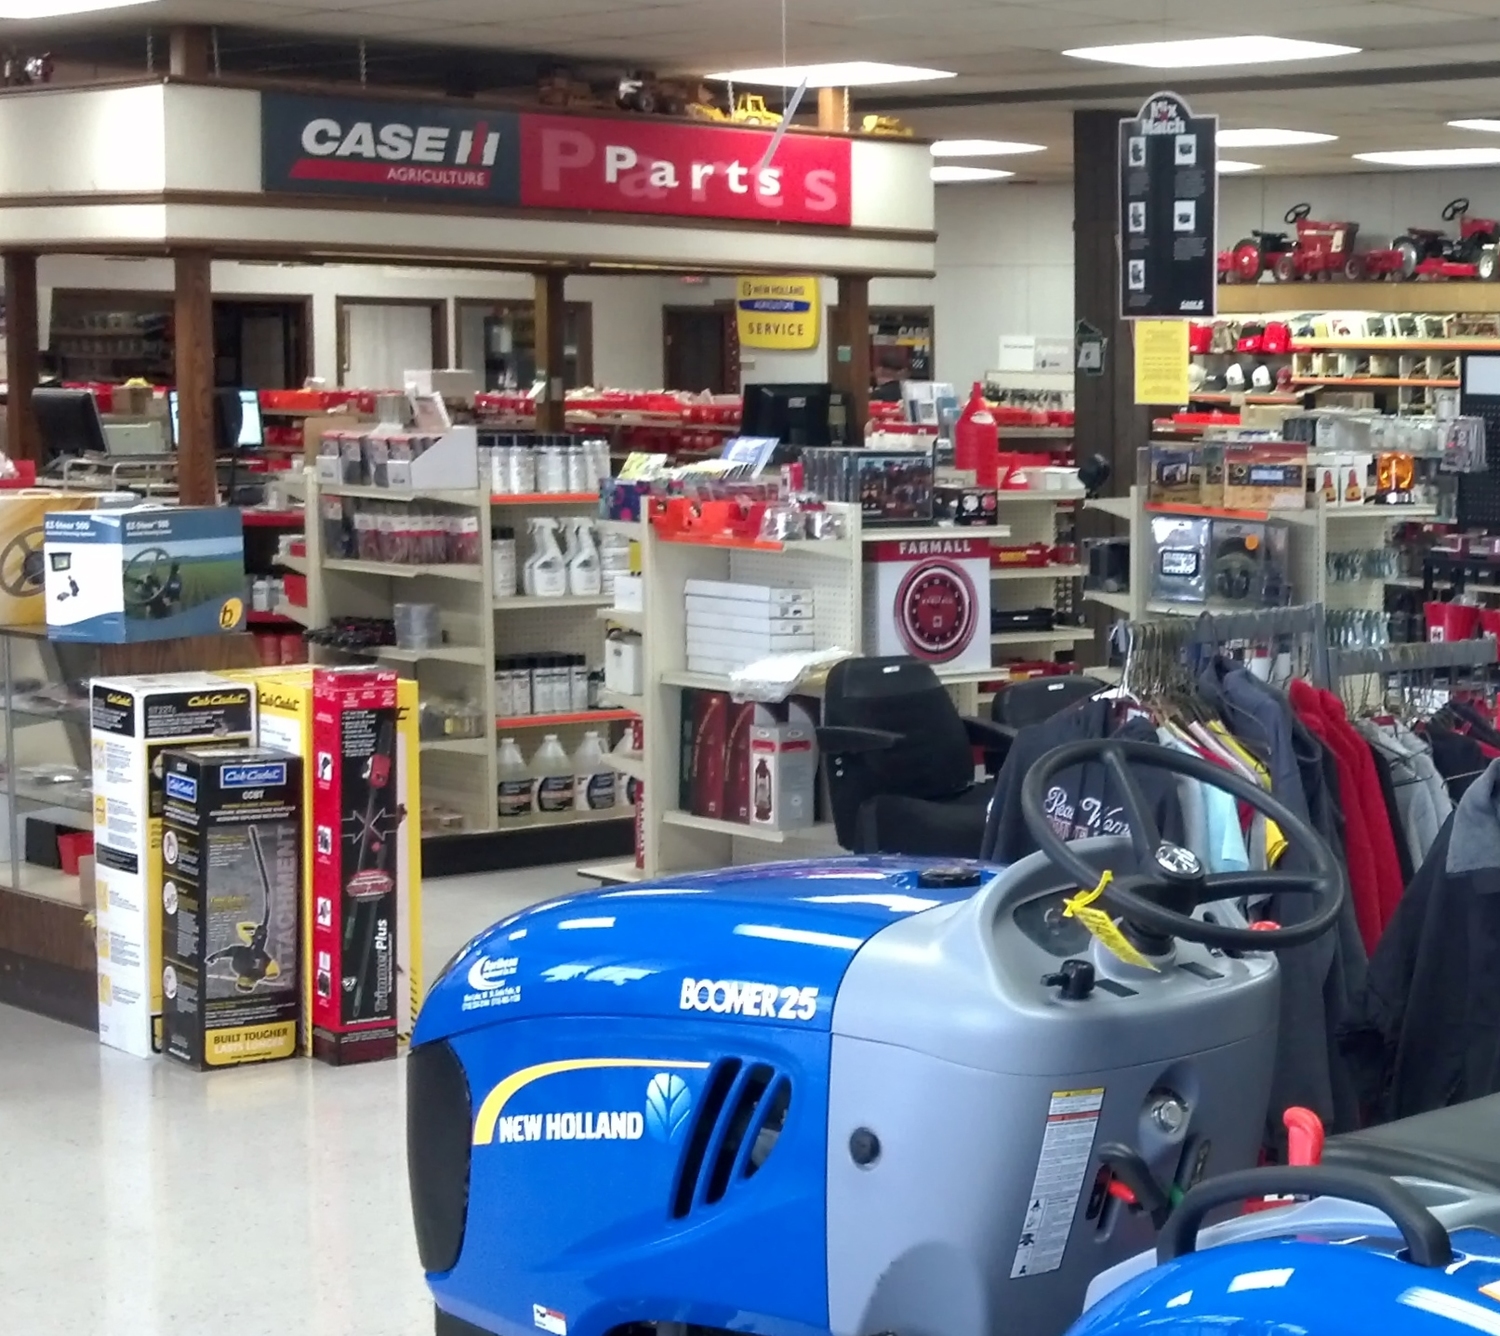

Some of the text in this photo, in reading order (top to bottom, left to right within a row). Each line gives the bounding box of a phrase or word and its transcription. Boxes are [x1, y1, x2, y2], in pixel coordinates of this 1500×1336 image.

[301, 118, 450, 163] CASE
[387, 167, 486, 186] AGRICULTURE
[604, 145, 780, 196] Parts
[748, 323, 804, 336] SERVICE
[899, 540, 972, 555] FARMALL
[188, 694, 247, 707] Cub Cadet
[259, 693, 300, 711] Cub Cadet
[225, 769, 280, 781] Cub Cadet
[680, 977, 819, 1021] BOOMER 25
[214, 1028, 288, 1045] BUILT TOUGHER
[499, 1111, 644, 1143] NEW HOLLAND
